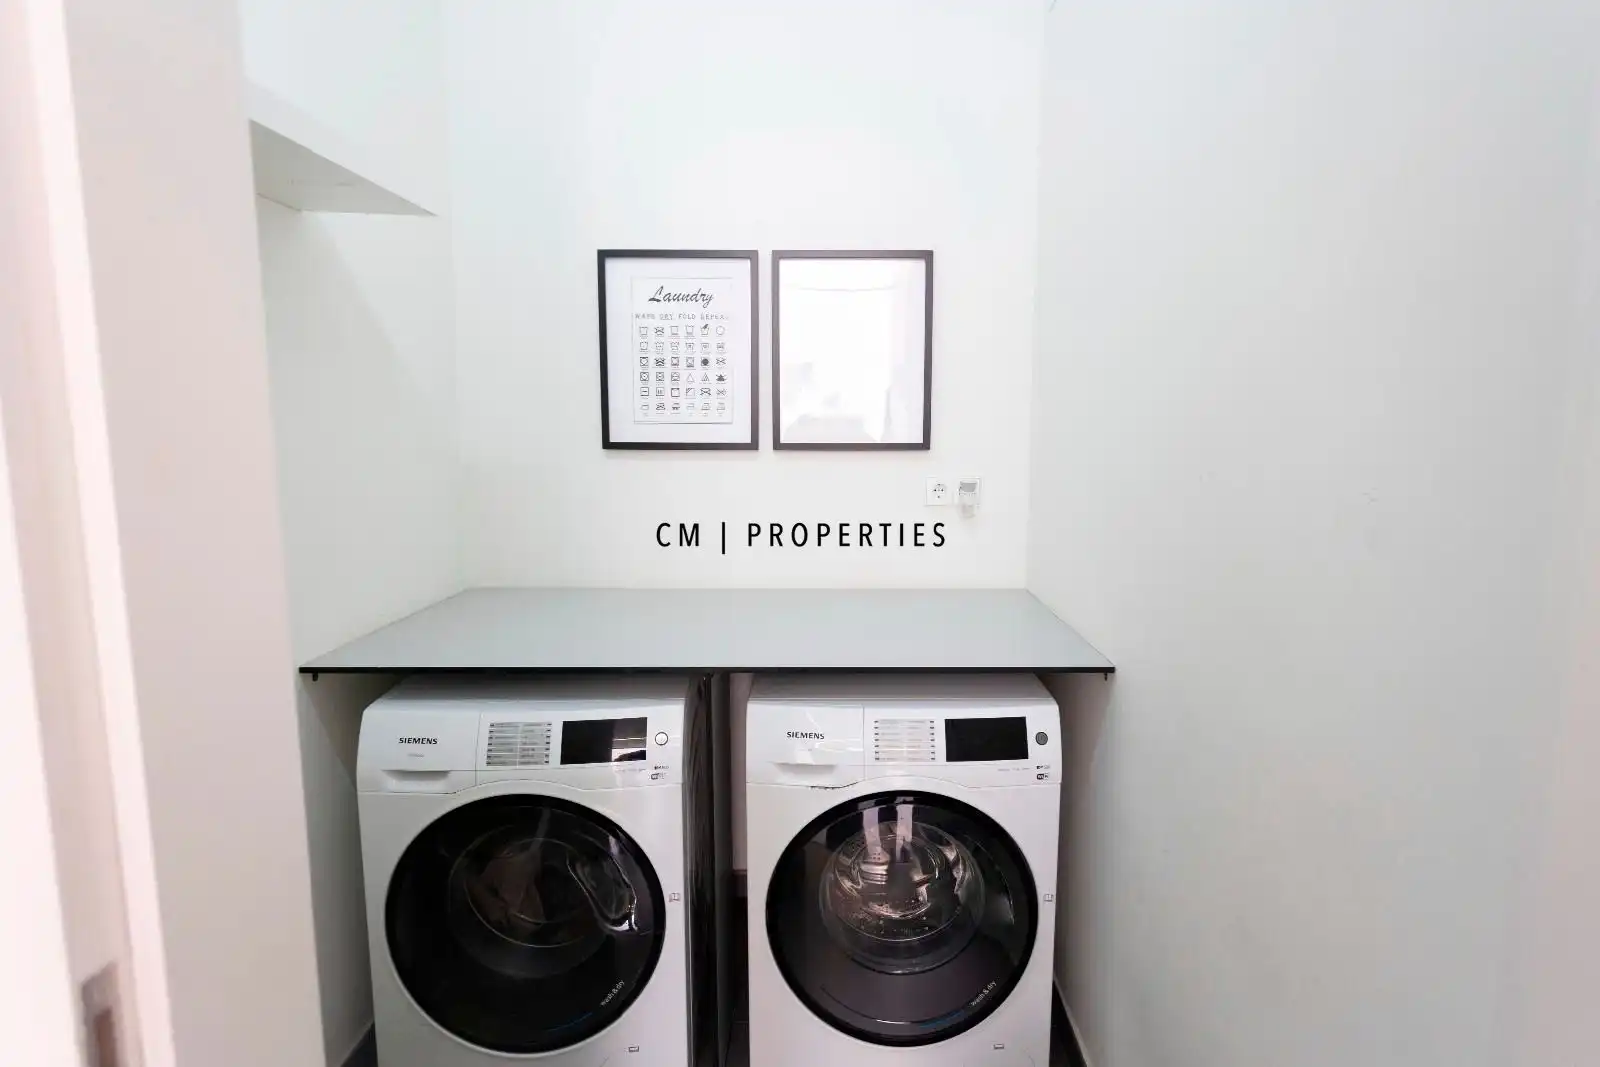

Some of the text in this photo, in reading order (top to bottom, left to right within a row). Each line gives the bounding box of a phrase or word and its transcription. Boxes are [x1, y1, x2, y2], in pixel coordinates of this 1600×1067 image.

[648, 285, 713, 308] Laundry
[786, 731, 824, 740] SIEMENS
[398, 737, 438, 745] SIEMENS
